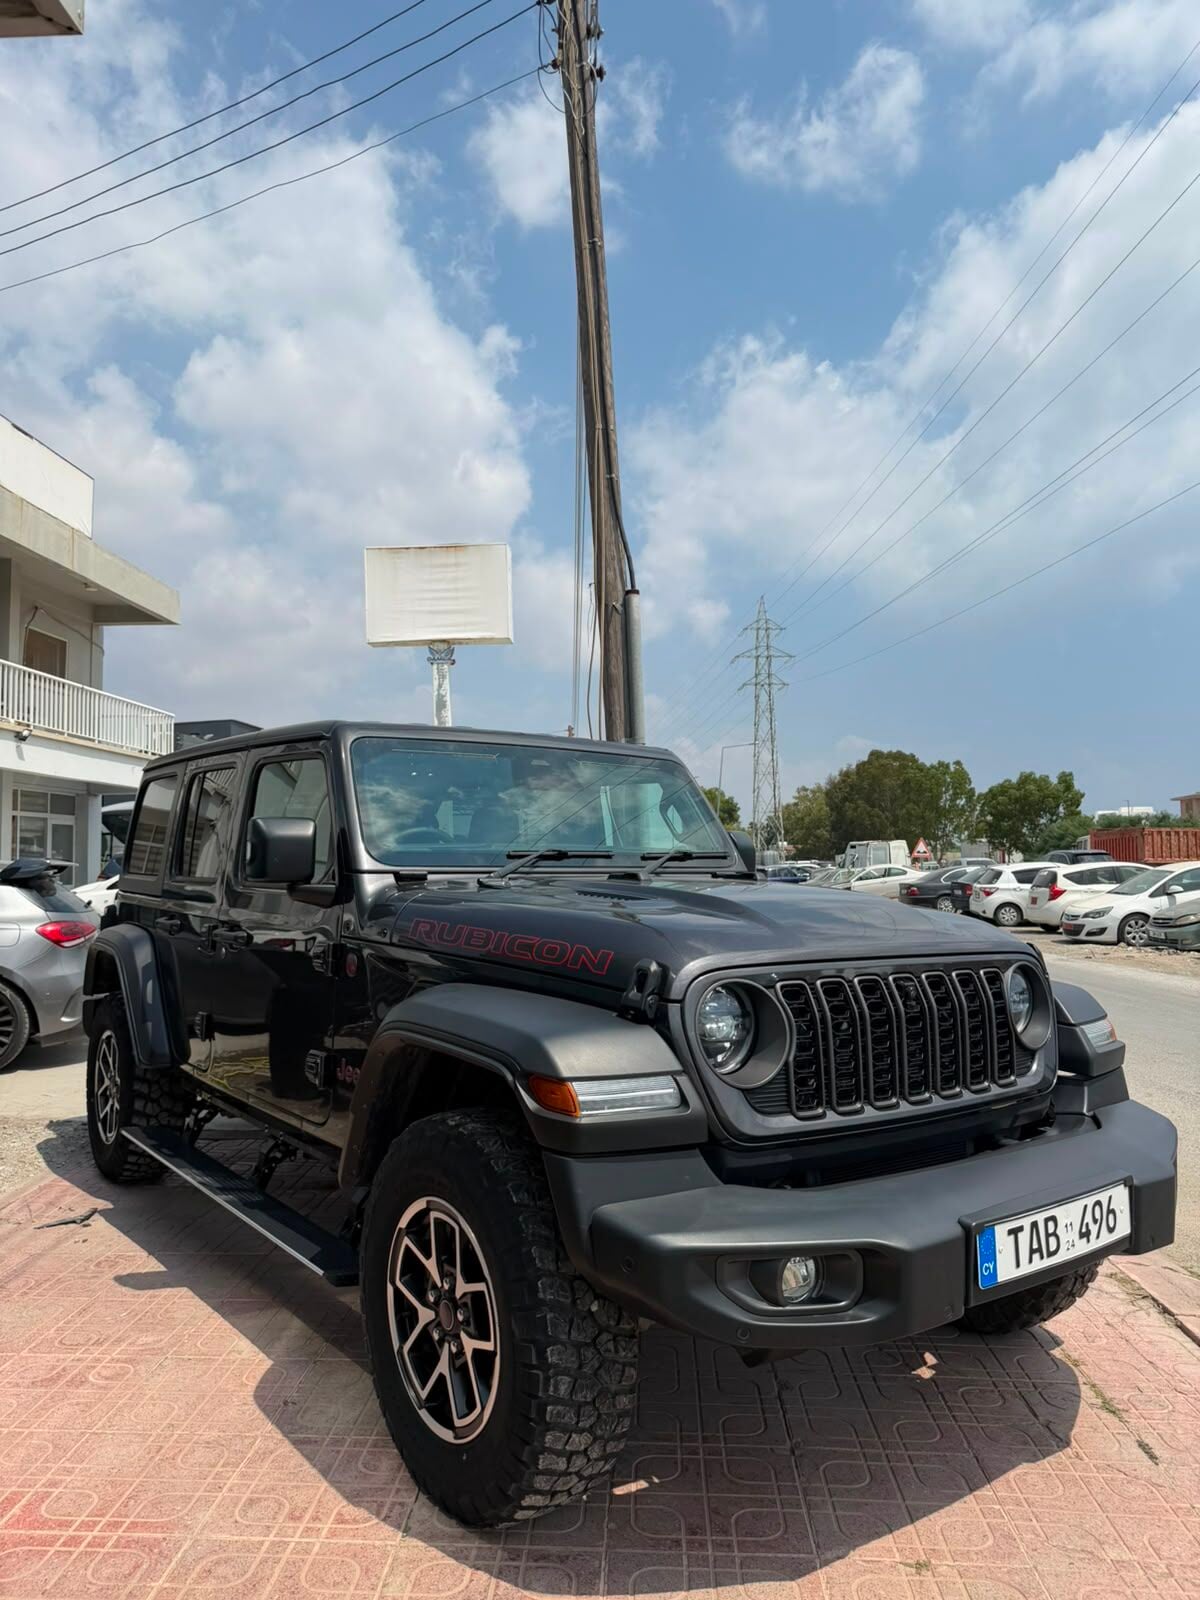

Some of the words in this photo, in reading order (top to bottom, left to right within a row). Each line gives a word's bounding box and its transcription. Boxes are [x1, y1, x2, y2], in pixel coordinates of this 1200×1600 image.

[408, 917, 615, 976] RUBICON
[336, 1057, 361, 1083] Jee
[1007, 1214, 1061, 1269] TAB
[1078, 1194, 1117, 1244] 496
[1064, 1221, 1074, 1233] 11
[1065, 1239, 1076, 1251] 24
[982, 1261, 994, 1276] CY
